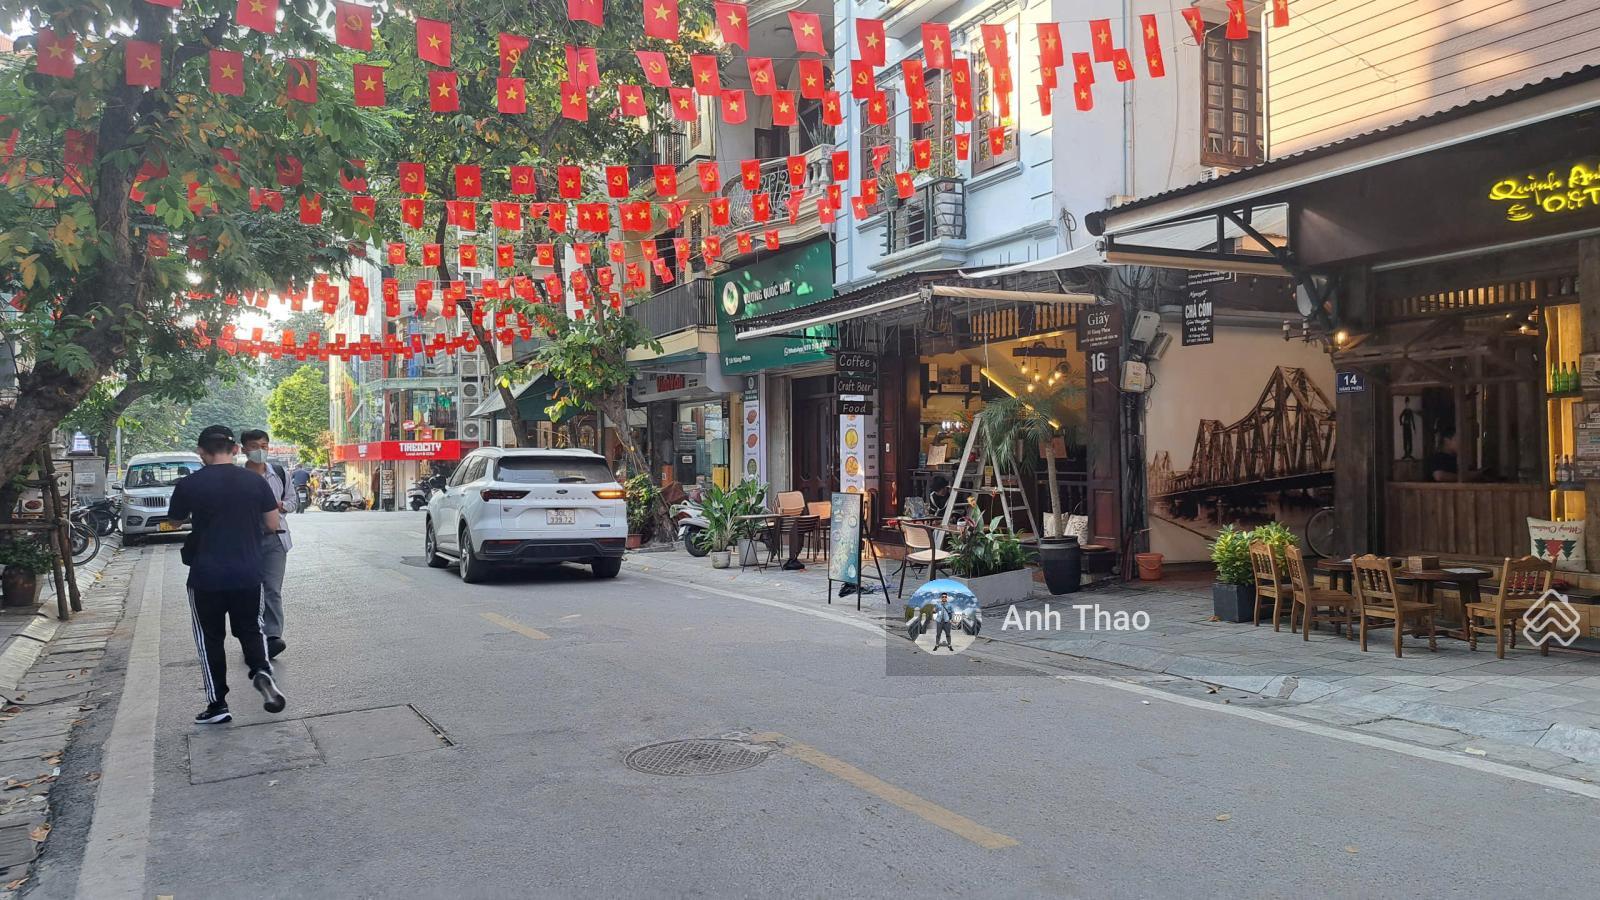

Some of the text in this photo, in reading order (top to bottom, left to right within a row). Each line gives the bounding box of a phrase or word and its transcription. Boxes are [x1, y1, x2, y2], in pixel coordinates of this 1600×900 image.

[1087, 311, 1110, 327] Giấy
[840, 355, 870, 367] Coffee
[1091, 352, 1106, 372] 16
[838, 380, 871, 392] Craft Beer
[1344, 375, 1357, 385] 14
[843, 403, 866, 413] Food
